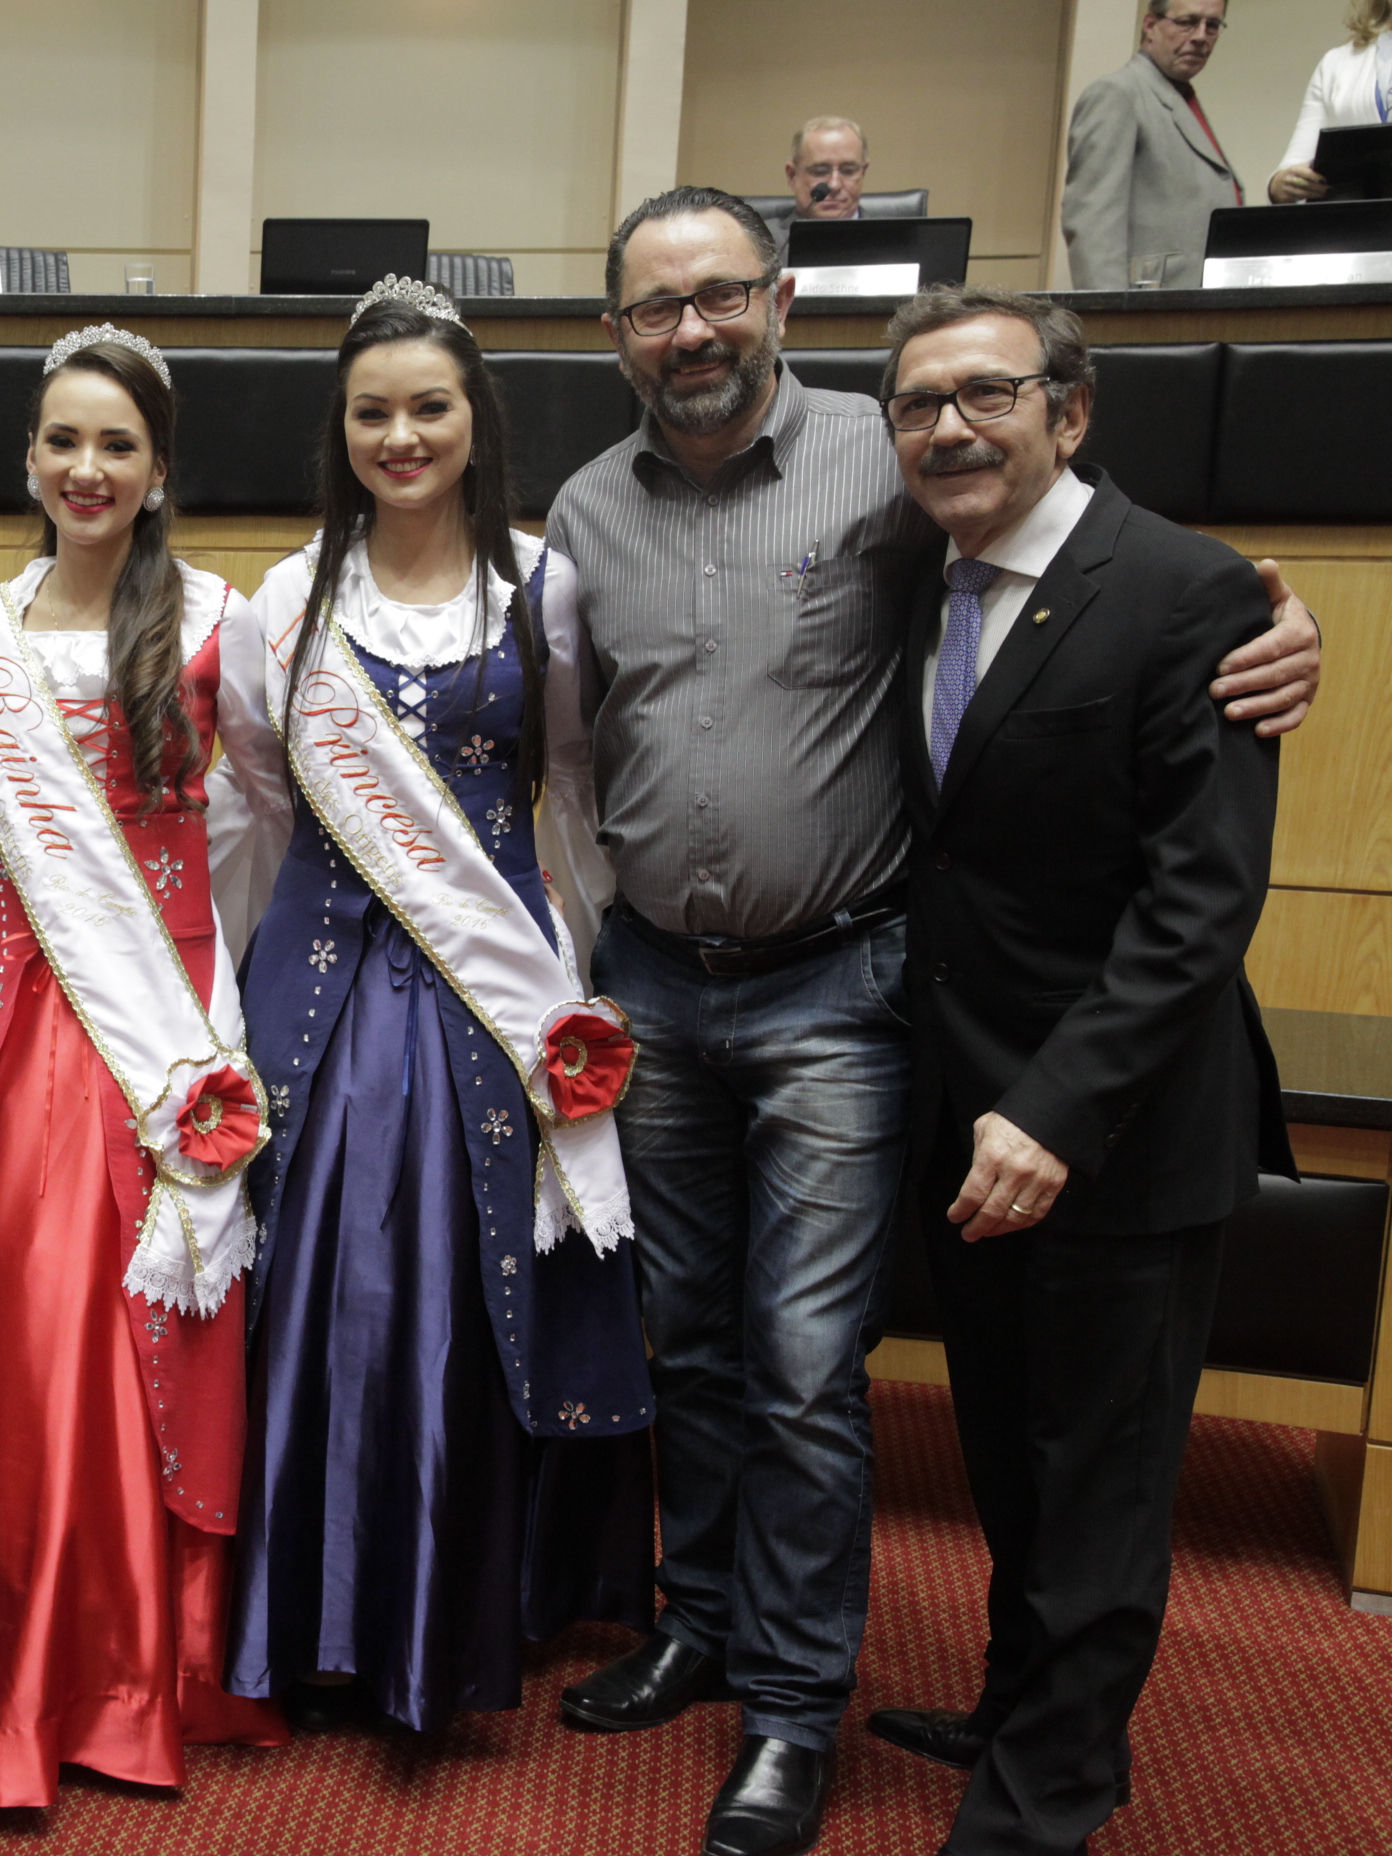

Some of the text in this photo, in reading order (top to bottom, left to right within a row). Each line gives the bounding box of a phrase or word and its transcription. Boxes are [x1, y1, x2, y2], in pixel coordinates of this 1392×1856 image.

[291, 670, 445, 872] Princesa
[314, 779, 405, 887] das Origens
[42, 874, 70, 891] Rio
[58, 902, 111, 927] 2016
[449, 914, 490, 929] 2016
